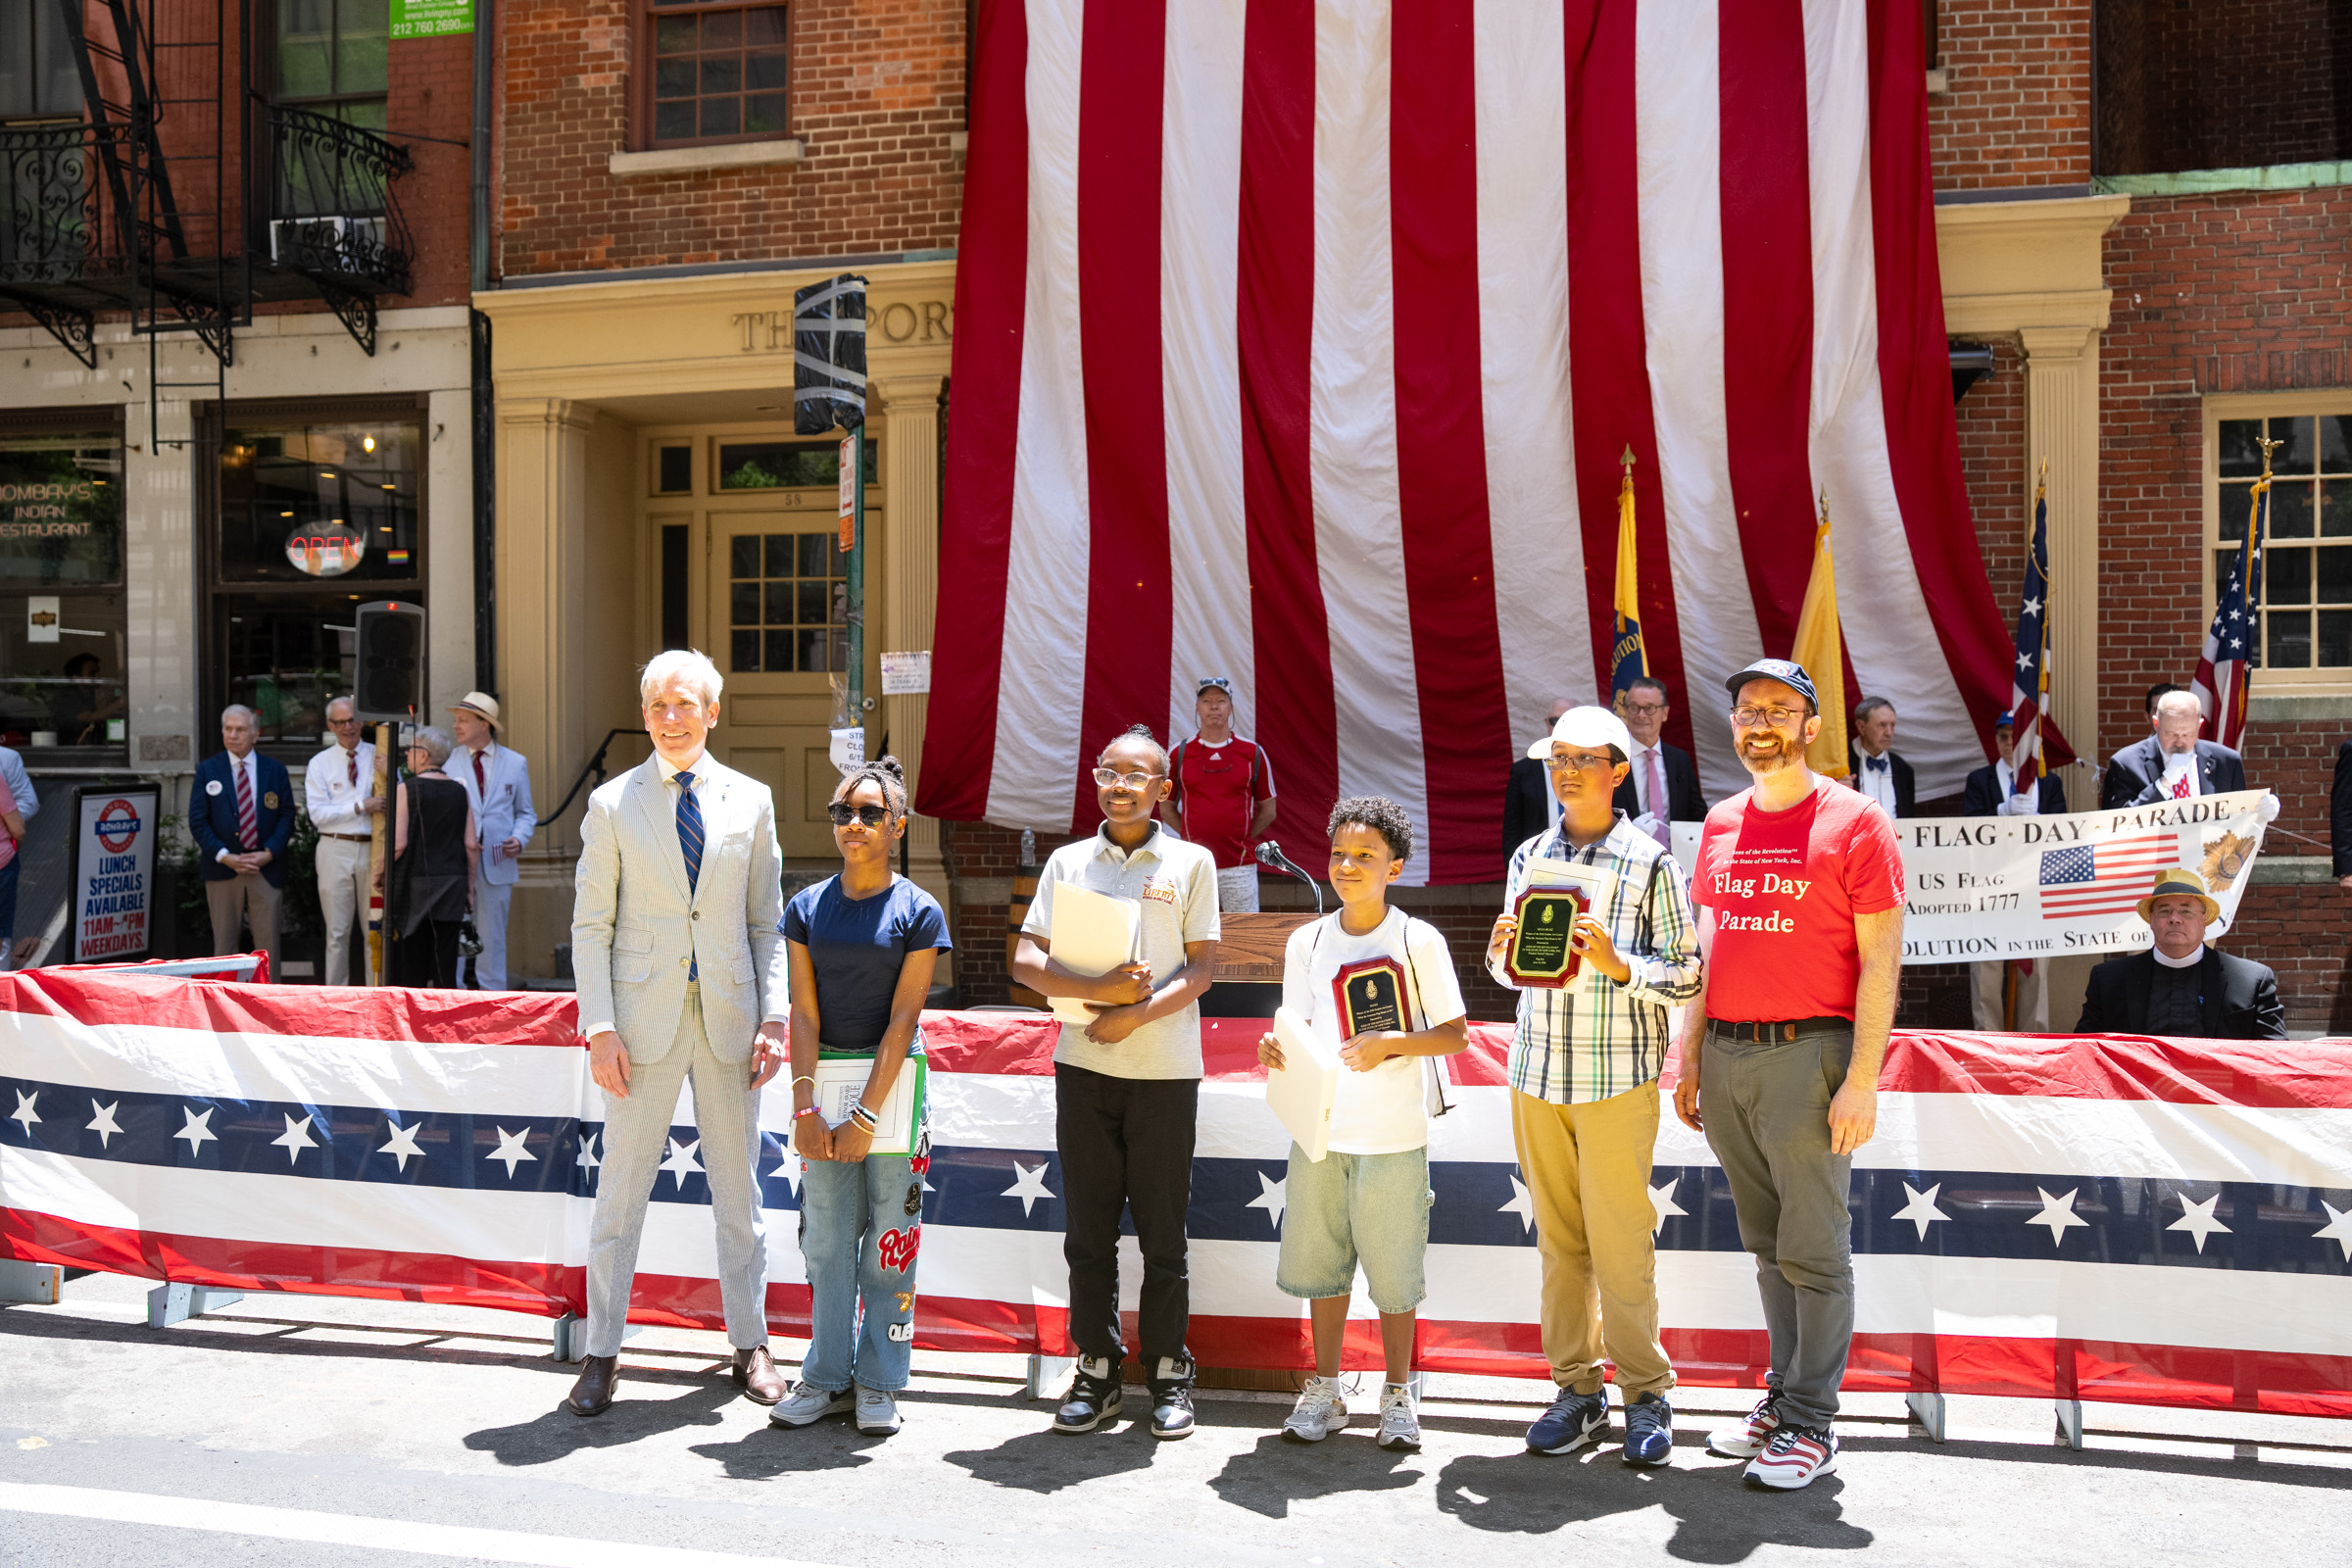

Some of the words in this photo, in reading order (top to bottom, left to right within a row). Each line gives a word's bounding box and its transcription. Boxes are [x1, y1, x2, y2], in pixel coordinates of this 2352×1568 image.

[393, 23, 412, 35] 212
[415, 21, 433, 33] 760
[435, 19, 461, 32] 2690
[0, 483, 91, 502] OMBAY'S
[785, 494, 802, 506] 58
[15, 505, 66, 518] INDIAN
[291, 536, 360, 562] OPEN
[1914, 824, 1998, 848] FLAG
[2023, 819, 2088, 844] DAY
[2112, 800, 2230, 833] PARADE
[99, 855, 135, 874] LUNCH
[90, 873, 142, 896] SPECIALS
[1714, 872, 1756, 899] Flag
[1761, 873, 1811, 900] Day
[1919, 873, 1944, 890] US
[85, 893, 144, 916] AVAILABLE
[1979, 893, 2020, 912] 1777
[1719, 910, 1794, 933] Parade
[2008, 942, 2023, 952] IN
[2024, 938, 2054, 951] THE
